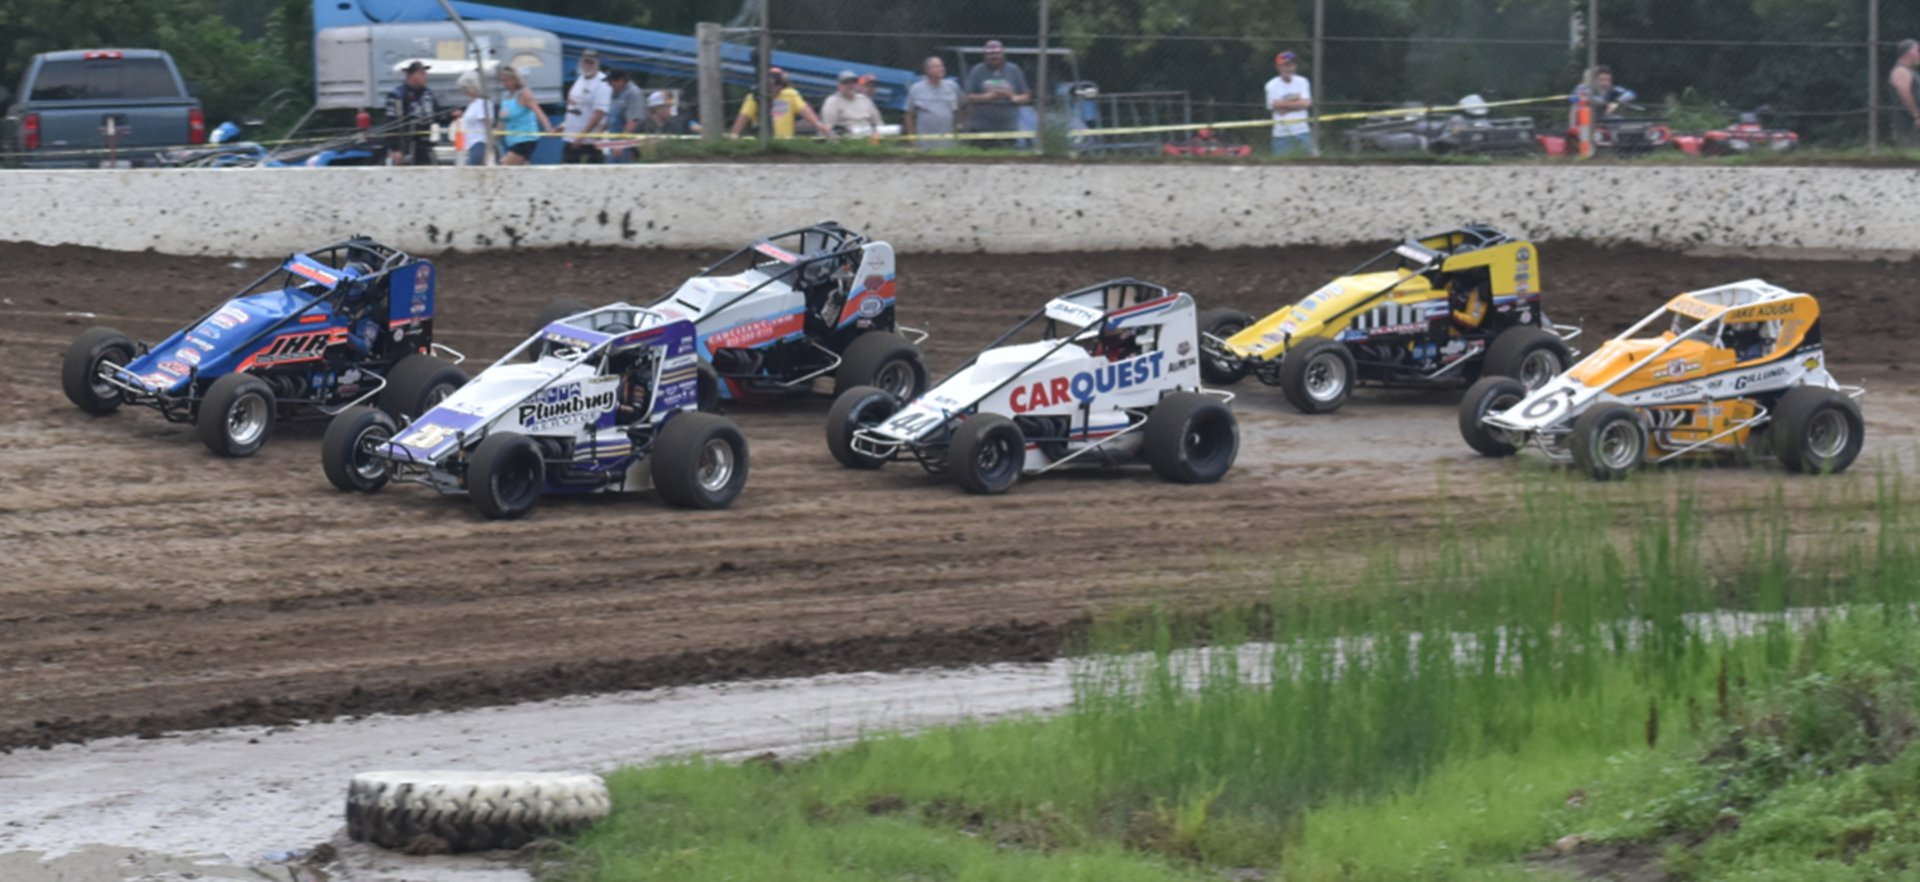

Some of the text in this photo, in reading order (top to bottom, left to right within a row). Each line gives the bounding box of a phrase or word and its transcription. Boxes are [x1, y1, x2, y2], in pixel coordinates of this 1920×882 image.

[1009, 351, 1164, 414] CARQUEST
[518, 391, 614, 425] Plumbing
[1522, 386, 1576, 419] 6
[889, 412, 938, 435] 44
